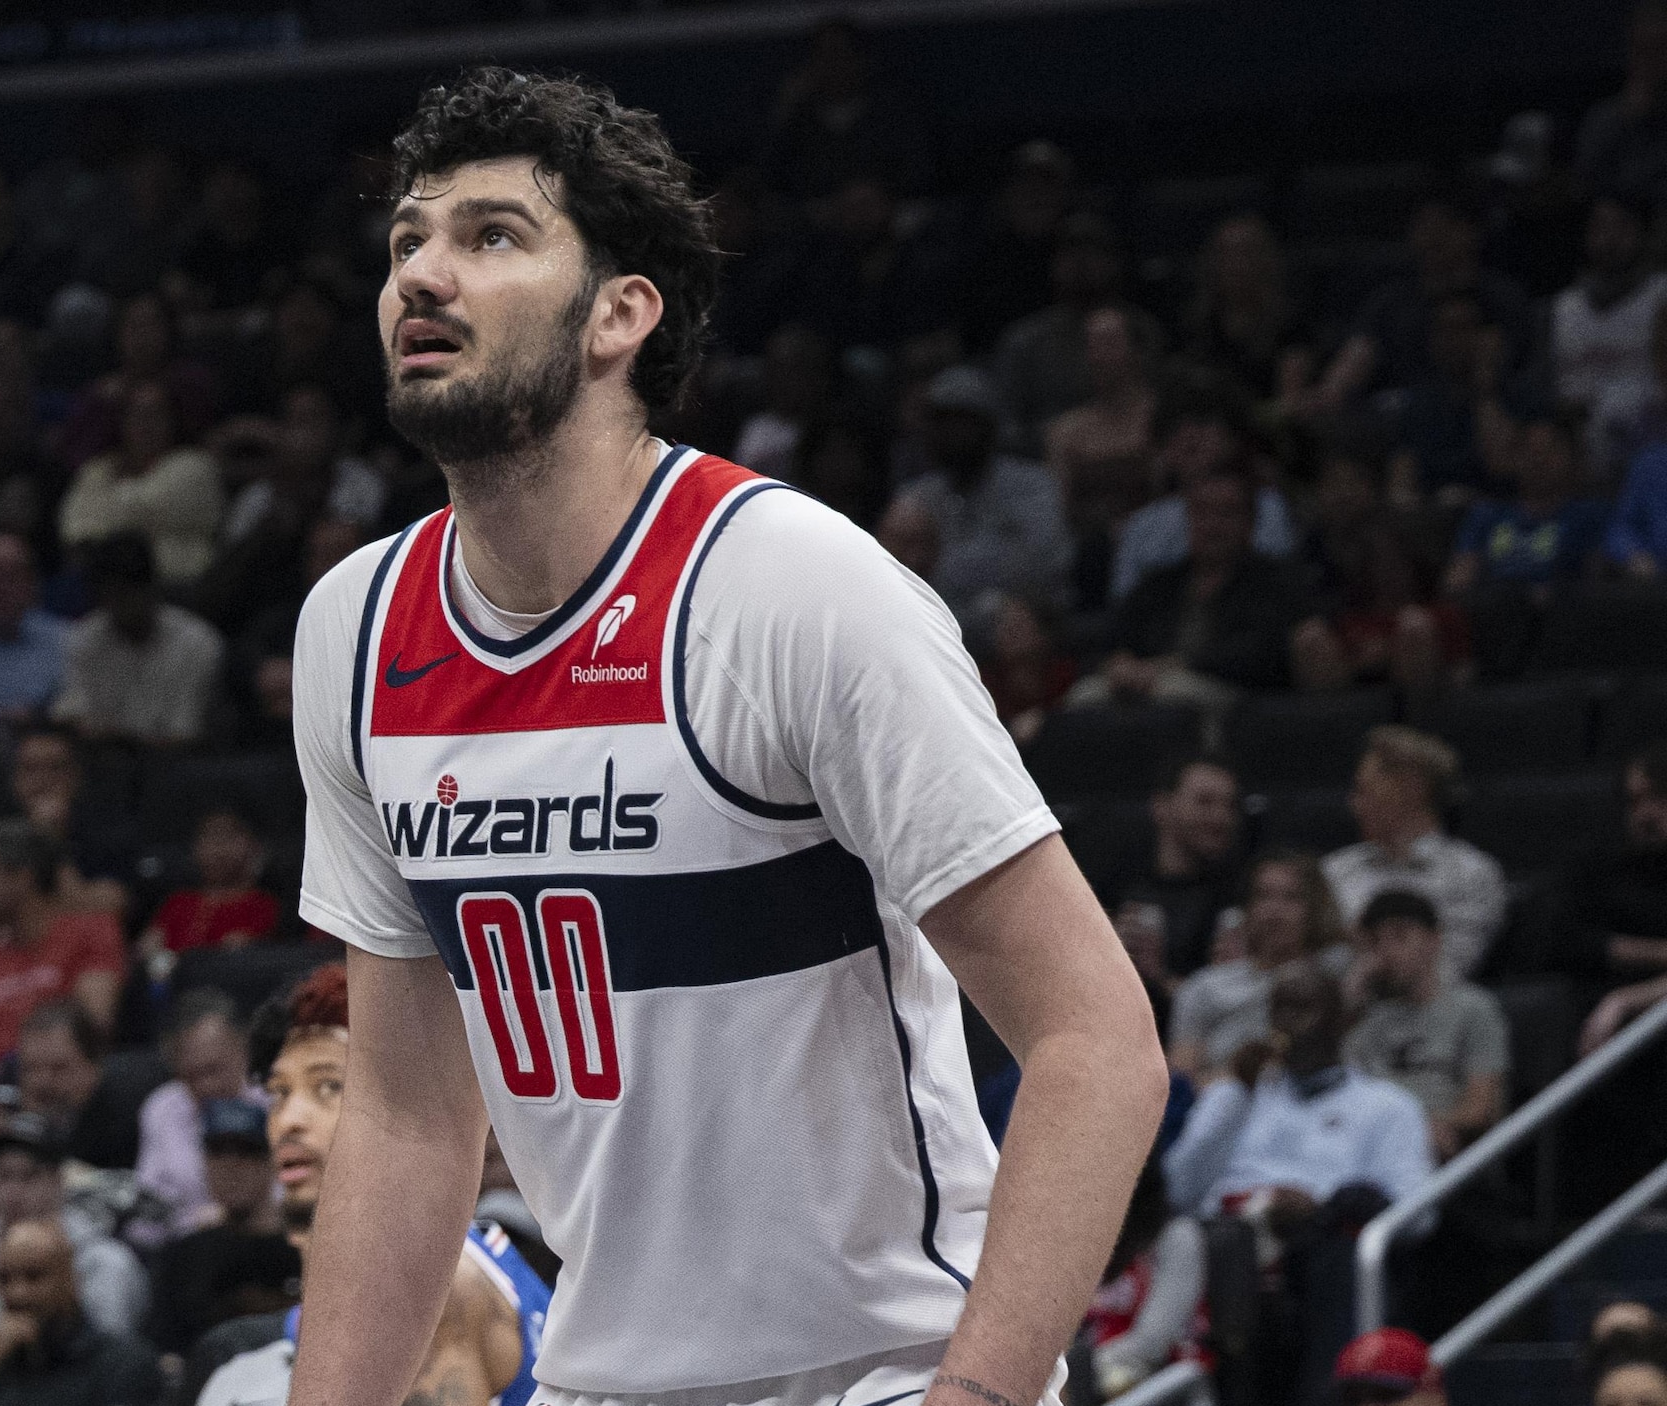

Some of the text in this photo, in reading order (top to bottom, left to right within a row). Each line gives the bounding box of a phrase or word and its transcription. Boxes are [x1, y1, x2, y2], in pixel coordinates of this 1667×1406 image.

[570, 661, 648, 685] Robinhood
[381, 751, 665, 860] wizards
[457, 888, 624, 1107] 00
